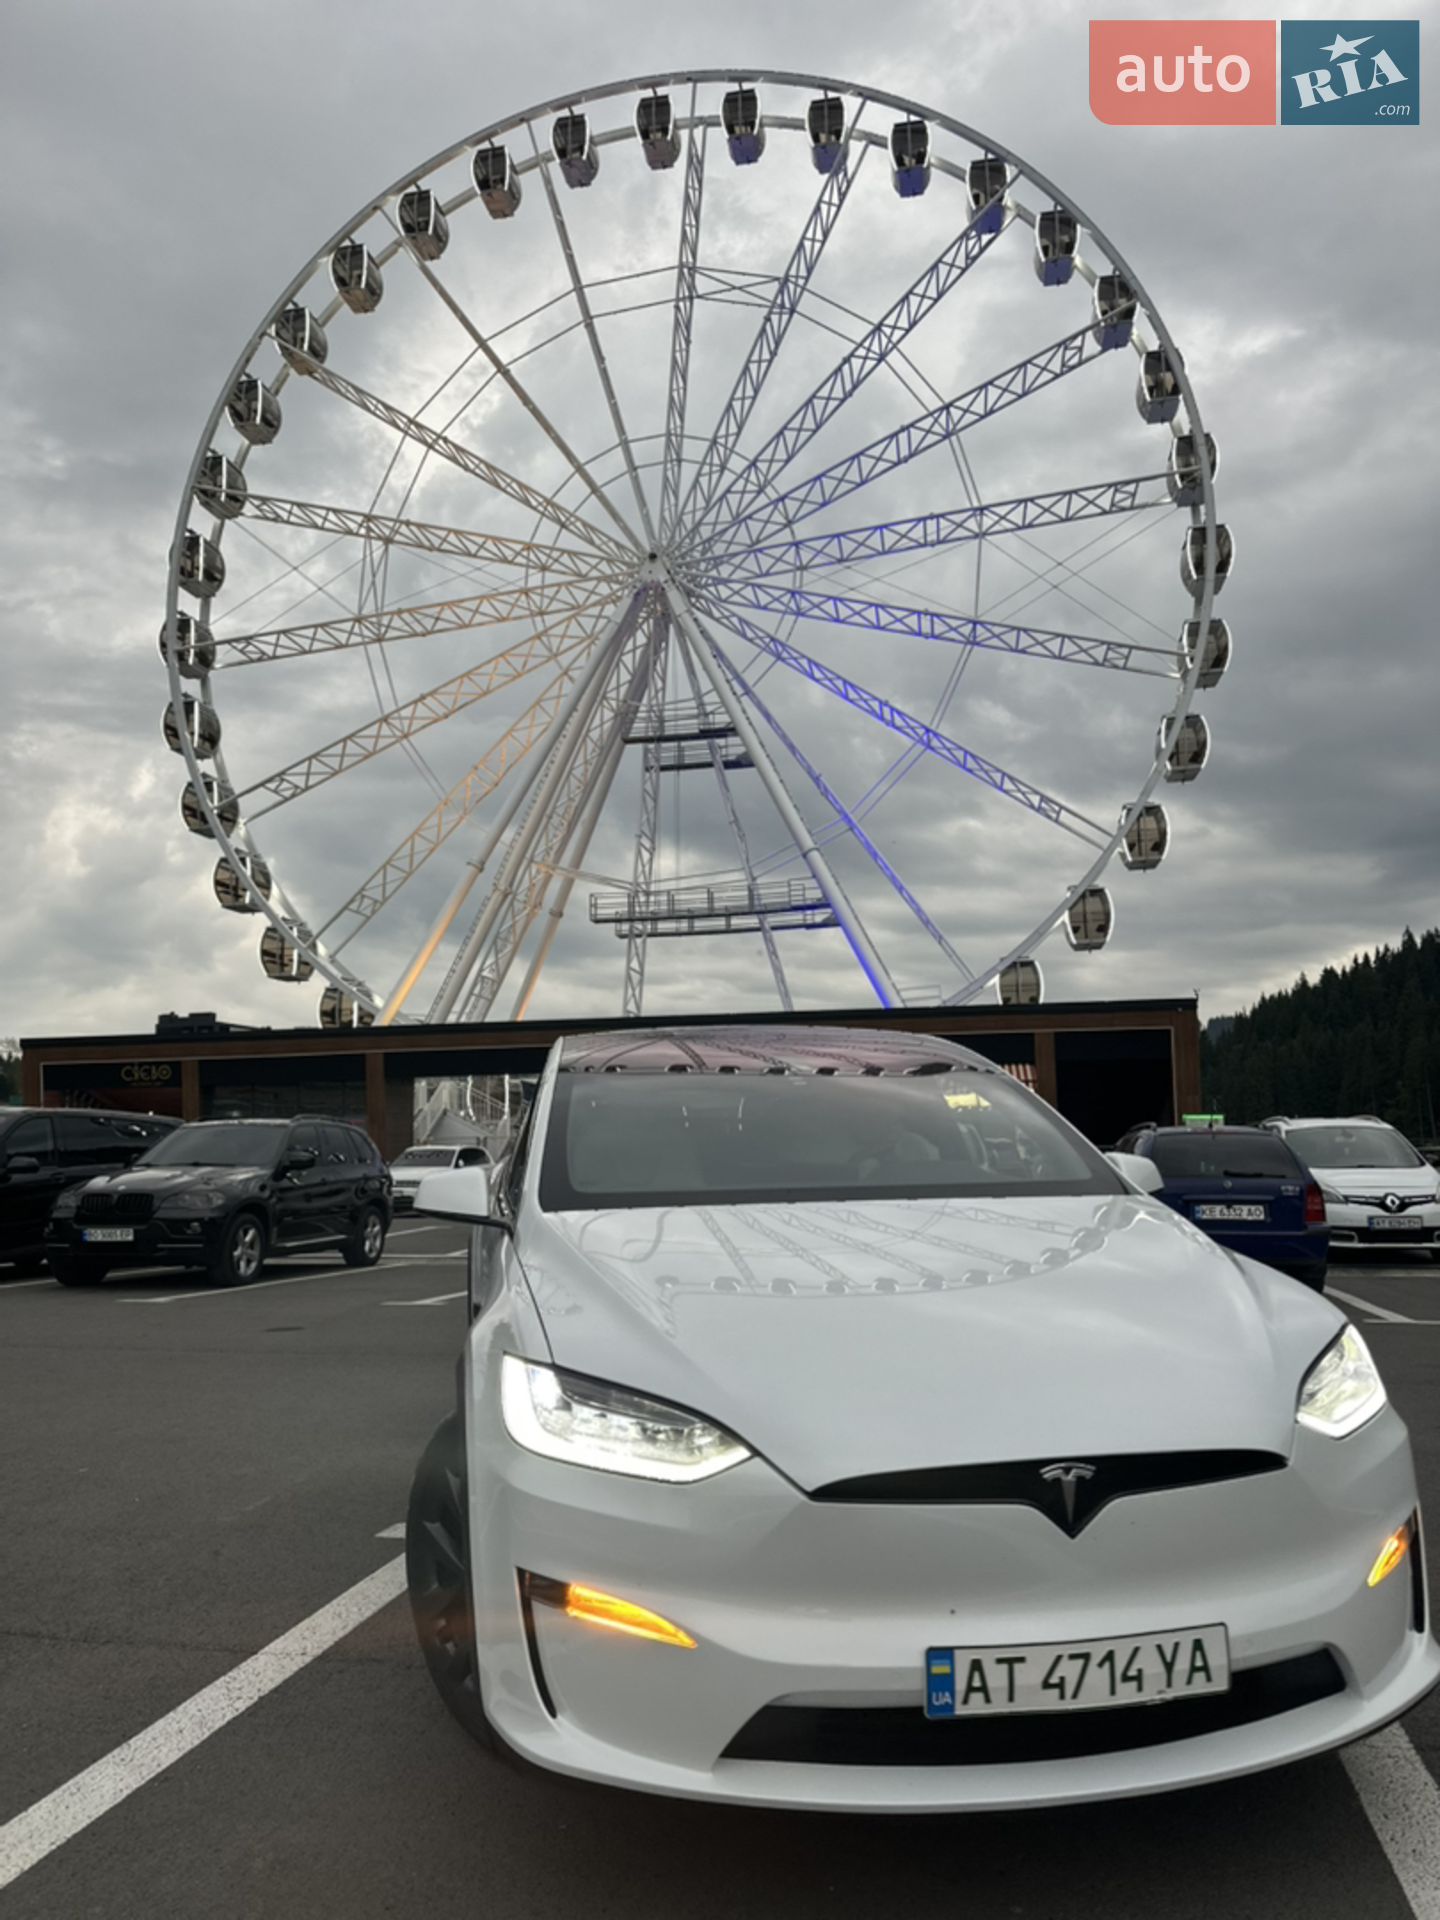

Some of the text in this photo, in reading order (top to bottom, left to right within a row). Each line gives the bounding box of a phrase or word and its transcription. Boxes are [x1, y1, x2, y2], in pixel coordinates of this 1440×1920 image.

[1201, 1206, 1216, 1217] KE
[961, 1638, 1212, 1705] AT 4714 YA
[931, 1692, 953, 1706] UA
